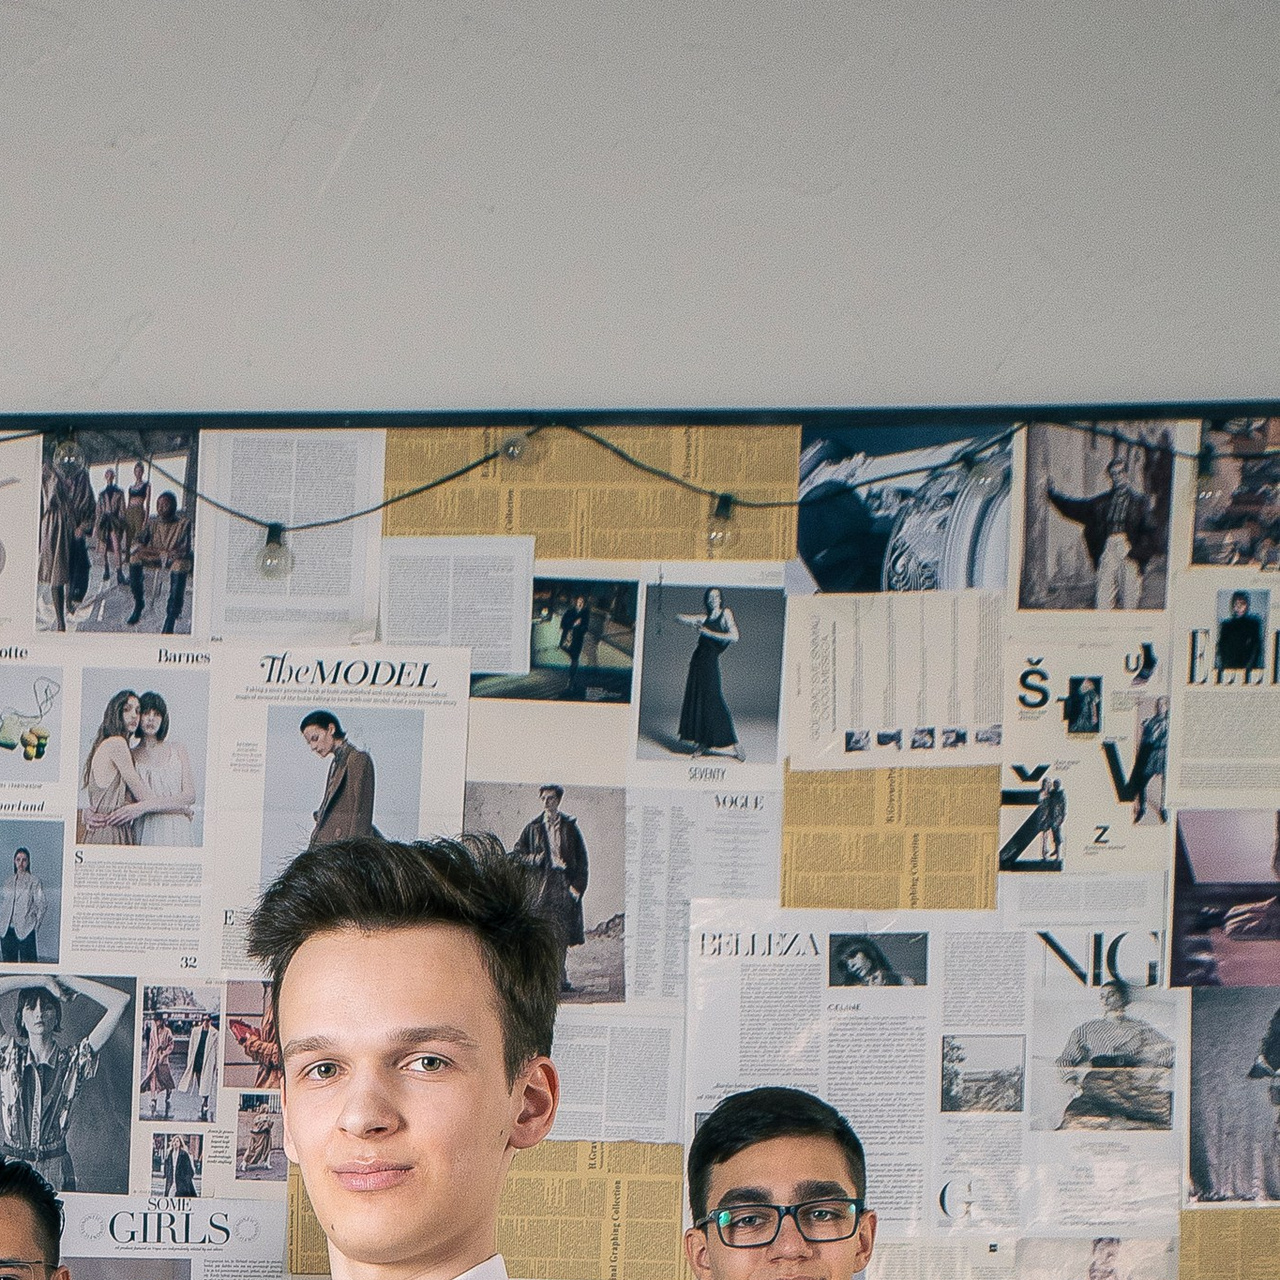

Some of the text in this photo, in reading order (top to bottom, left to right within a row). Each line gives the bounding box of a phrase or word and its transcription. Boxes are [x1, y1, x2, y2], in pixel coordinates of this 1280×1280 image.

[157, 648, 211, 665] Barnes
[260, 650, 439, 689] The MODEL
[688, 766, 727, 780] SEVENTY
[714, 794, 765, 811] VOGUE
[701, 932, 821, 957] BELLEZA
[180, 956, 198, 969] 32
[147, 1197, 192, 1212] SOME
[108, 1210, 231, 1245] GIRLS
[609, 1180, 621, 1263] Graphing Collection
